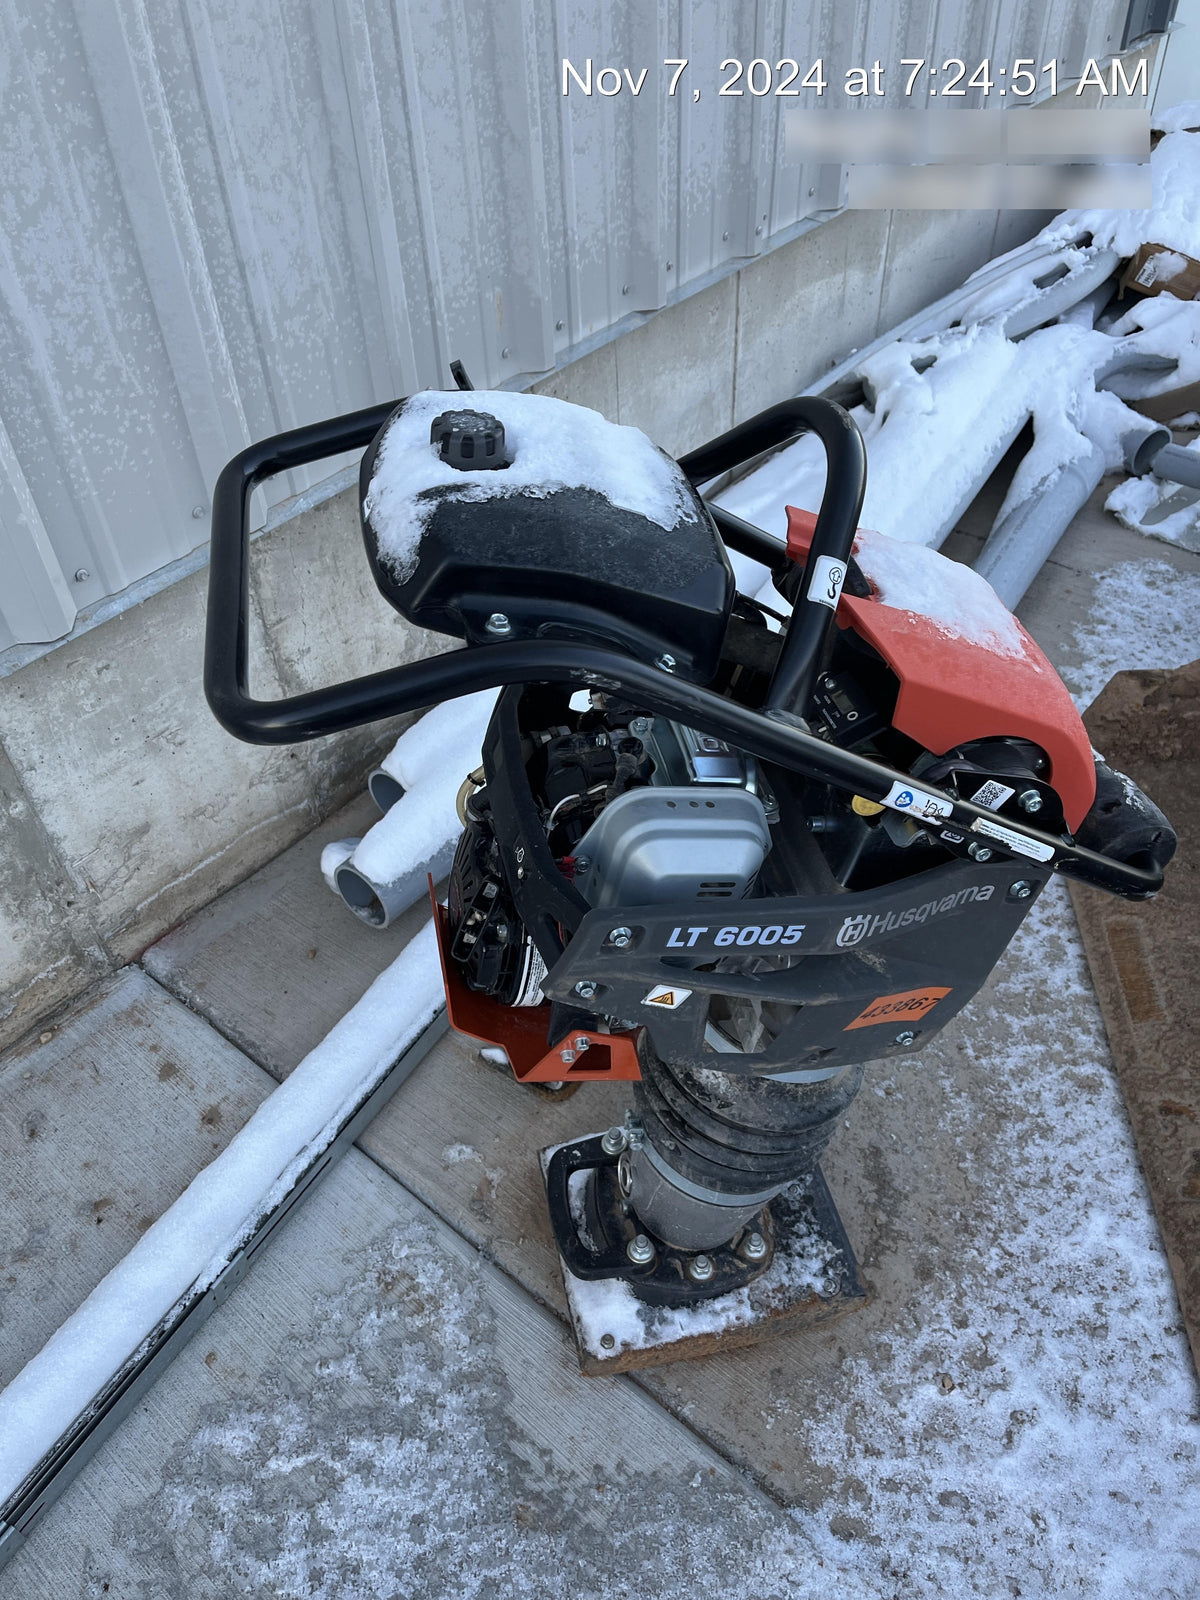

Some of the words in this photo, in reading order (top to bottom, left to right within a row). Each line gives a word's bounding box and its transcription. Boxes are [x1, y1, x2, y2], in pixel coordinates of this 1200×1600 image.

[867, 884, 996, 937] Husqvarna
[666, 927, 708, 948] LT
[713, 924, 806, 947] 6005
[859, 996, 942, 1020] 433867
